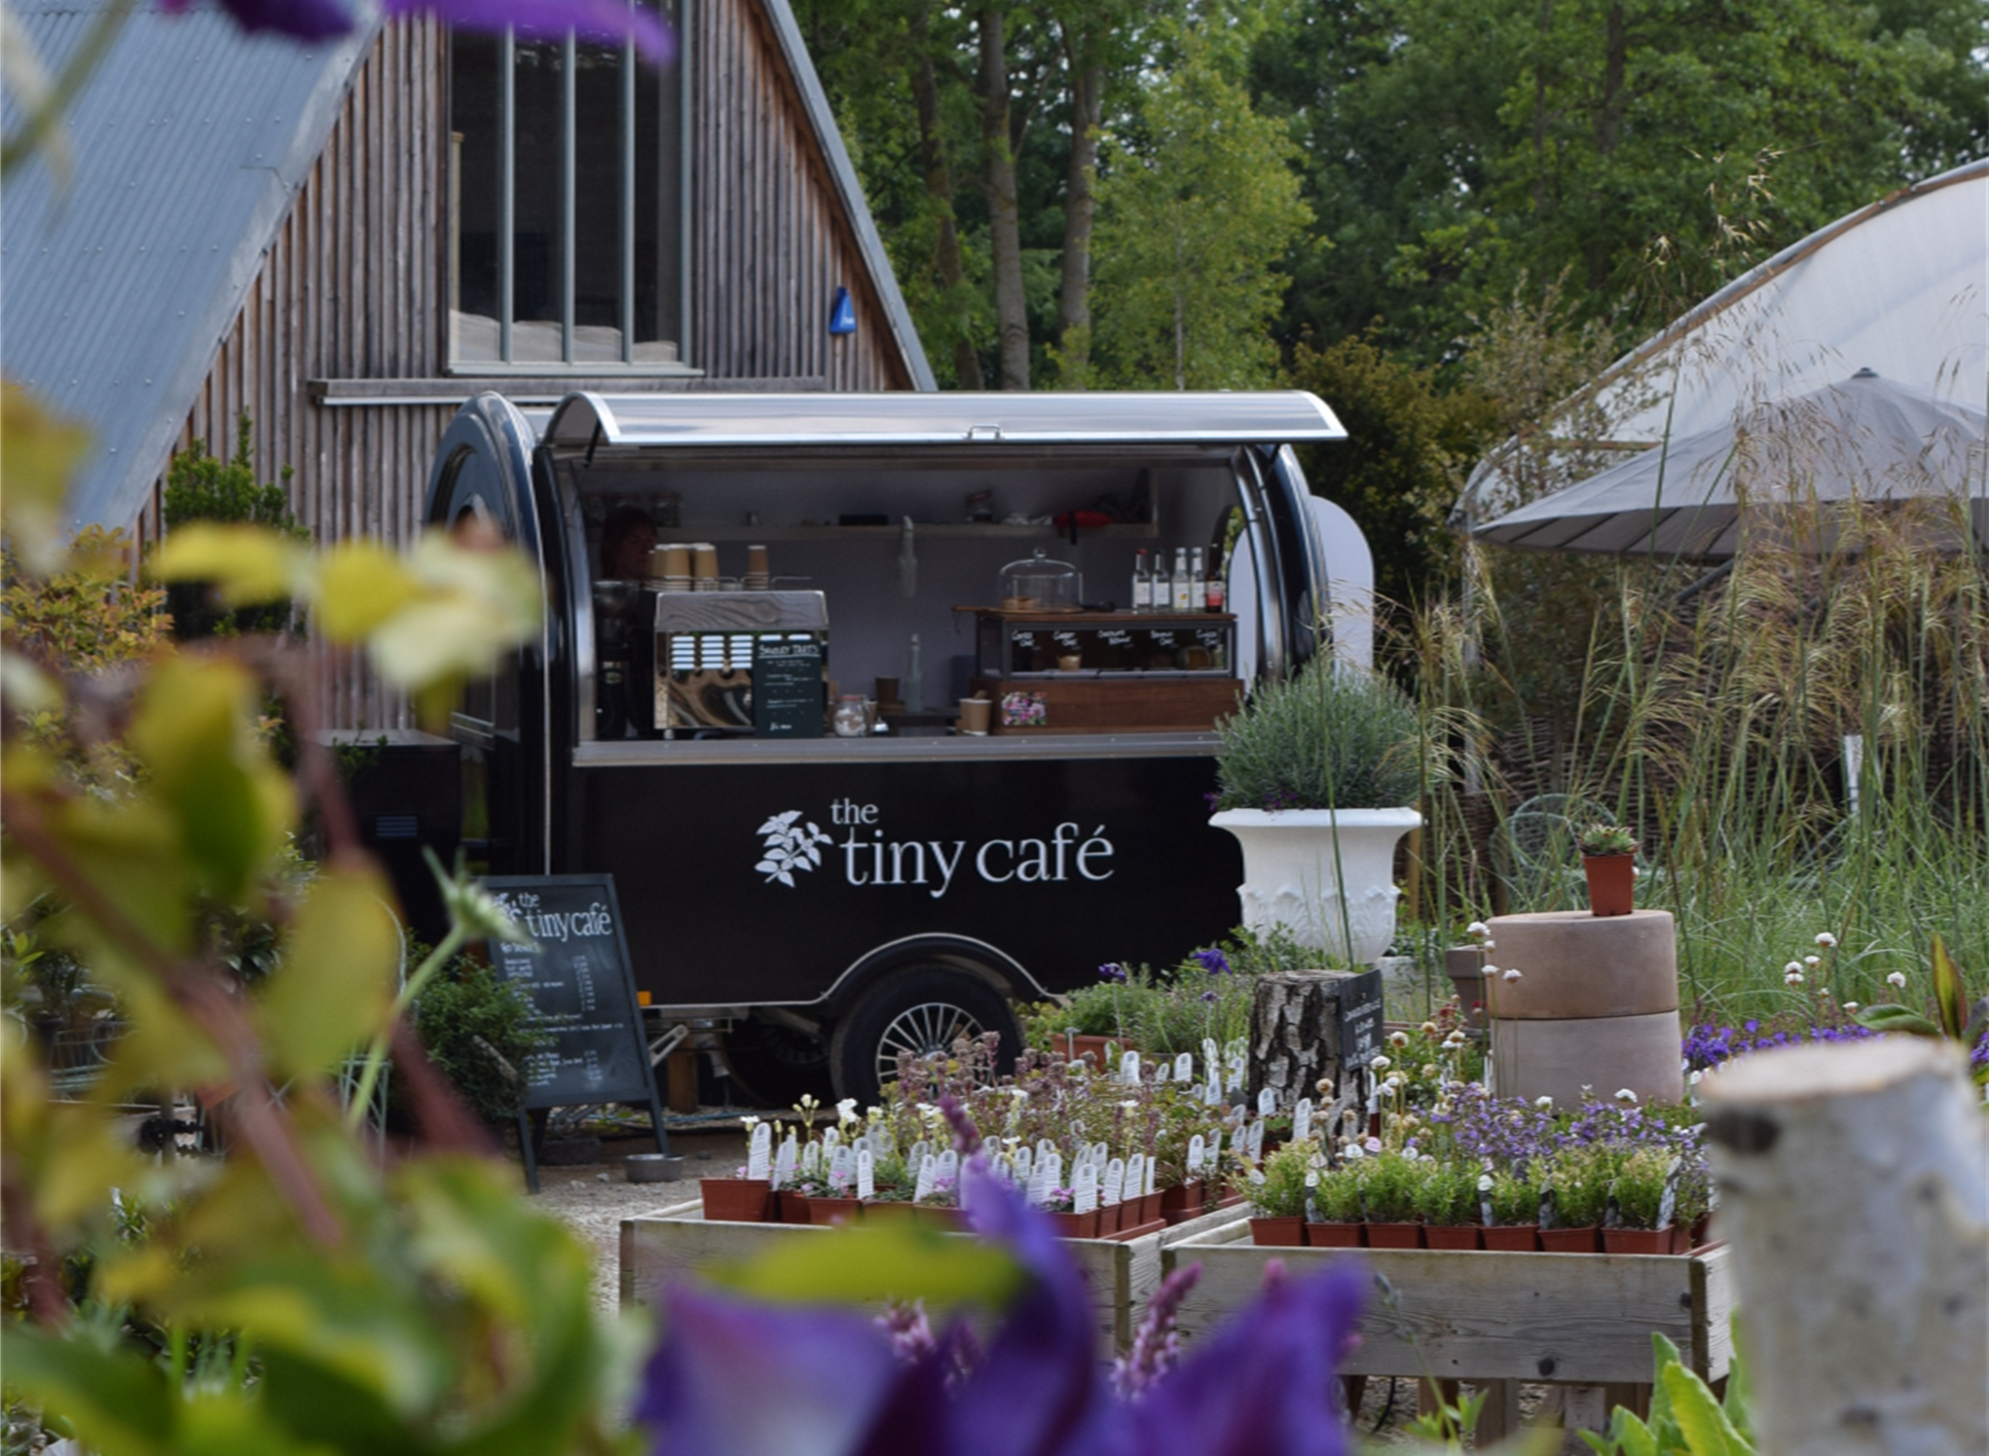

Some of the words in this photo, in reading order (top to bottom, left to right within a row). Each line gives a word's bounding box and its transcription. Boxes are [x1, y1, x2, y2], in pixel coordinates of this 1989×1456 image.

[830, 797, 879, 825] the
[838, 826, 967, 899] tiny
[975, 822, 1115, 883] café
[518, 891, 541, 908] the
[524, 909, 570, 942] tiny
[570, 901, 613, 937] café
